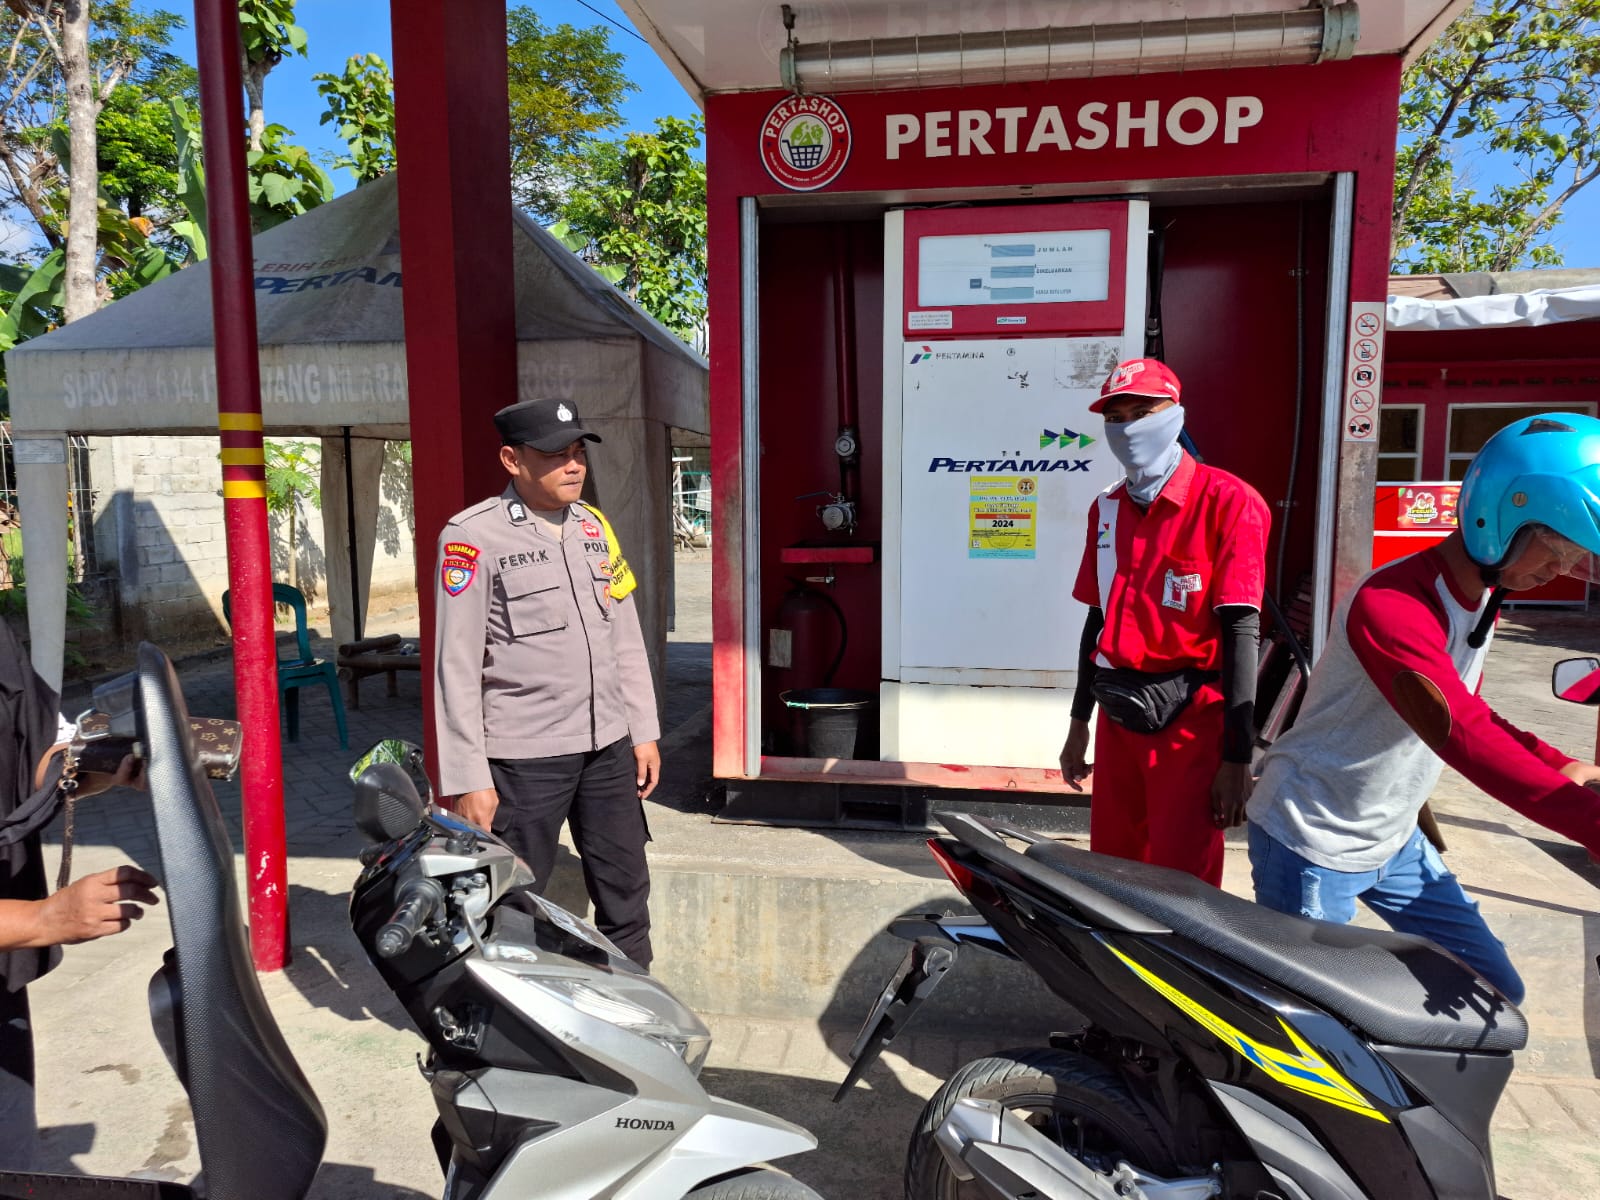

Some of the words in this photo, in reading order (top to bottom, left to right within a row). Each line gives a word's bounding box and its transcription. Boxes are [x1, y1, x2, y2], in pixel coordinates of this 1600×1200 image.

[764, 98, 846, 138] PERTASHOP
[886, 95, 1264, 160] PERTASHOP
[936, 352, 984, 360] PERTAMINA
[928, 457, 1093, 473] PERTAMAX
[992, 520, 1014, 528] 2024
[499, 549, 550, 569] FERY.K
[615, 1117, 676, 1131] HONDA
